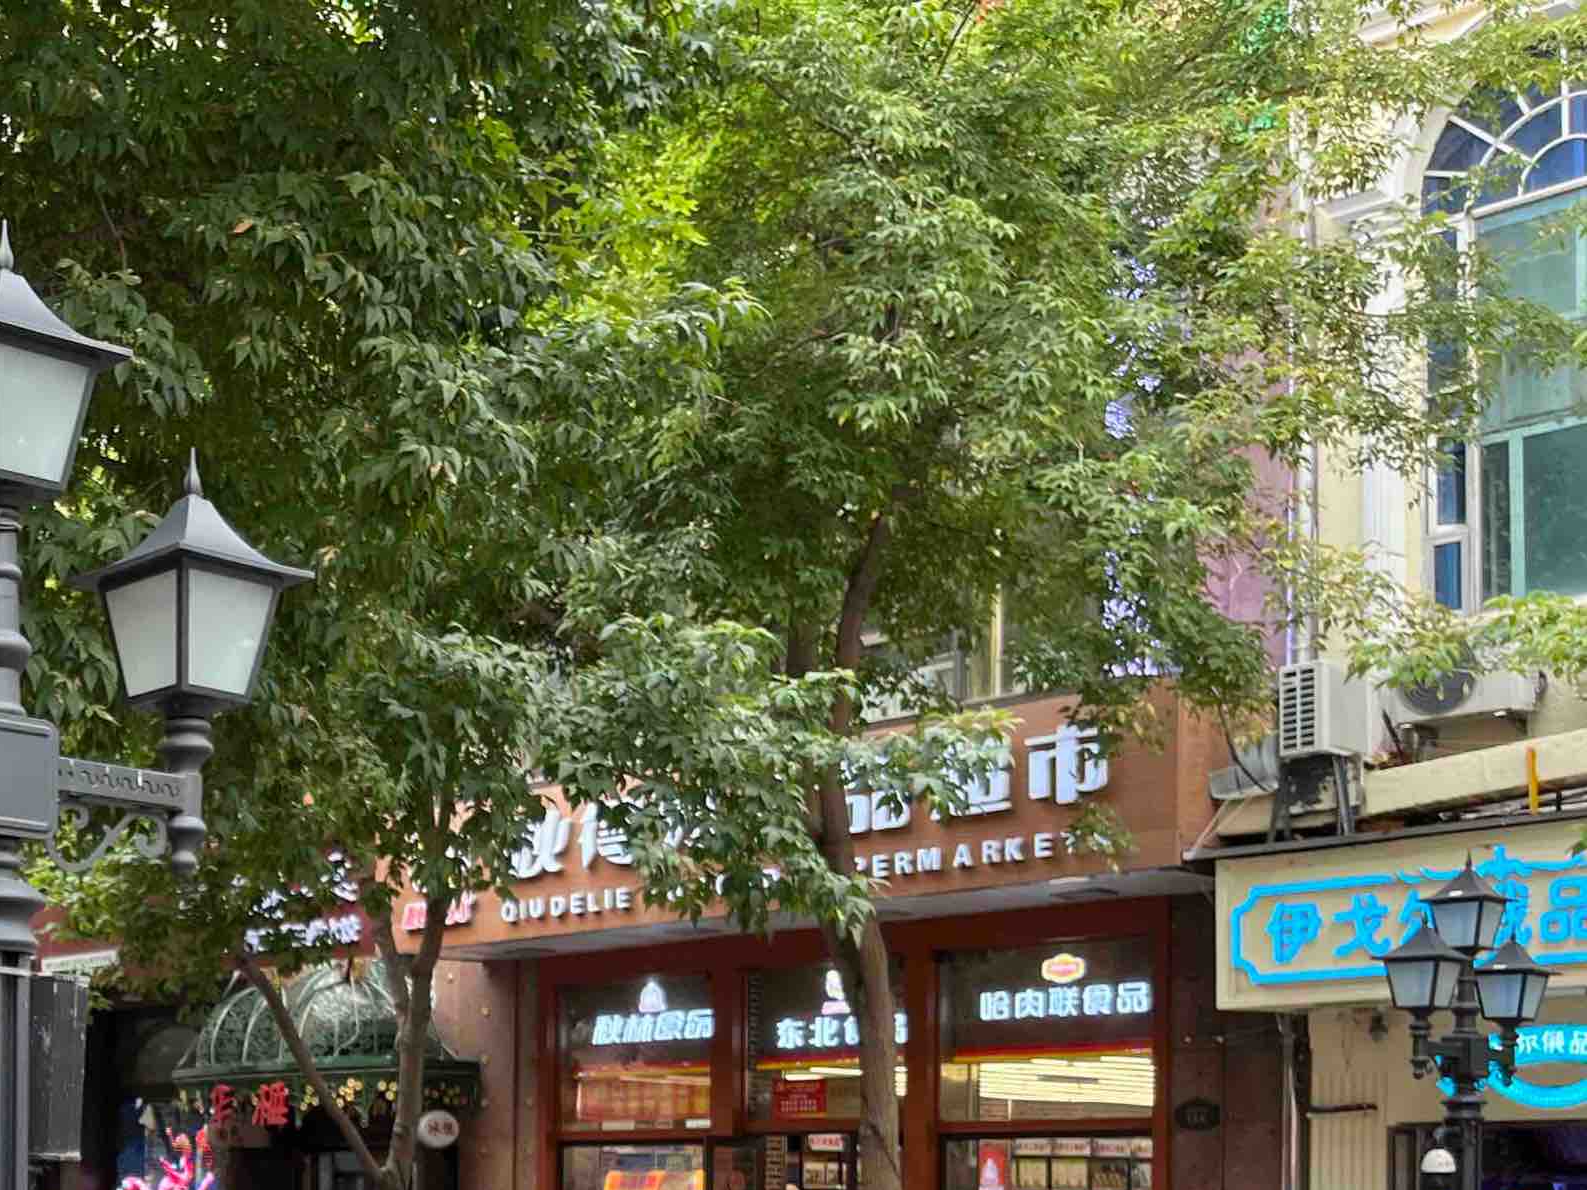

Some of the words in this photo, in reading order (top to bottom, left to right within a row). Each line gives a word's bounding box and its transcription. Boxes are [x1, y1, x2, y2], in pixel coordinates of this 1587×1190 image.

[500, 886, 633, 924] QIUDELIE
[979, 981, 1152, 1022] 哈肉联食品
